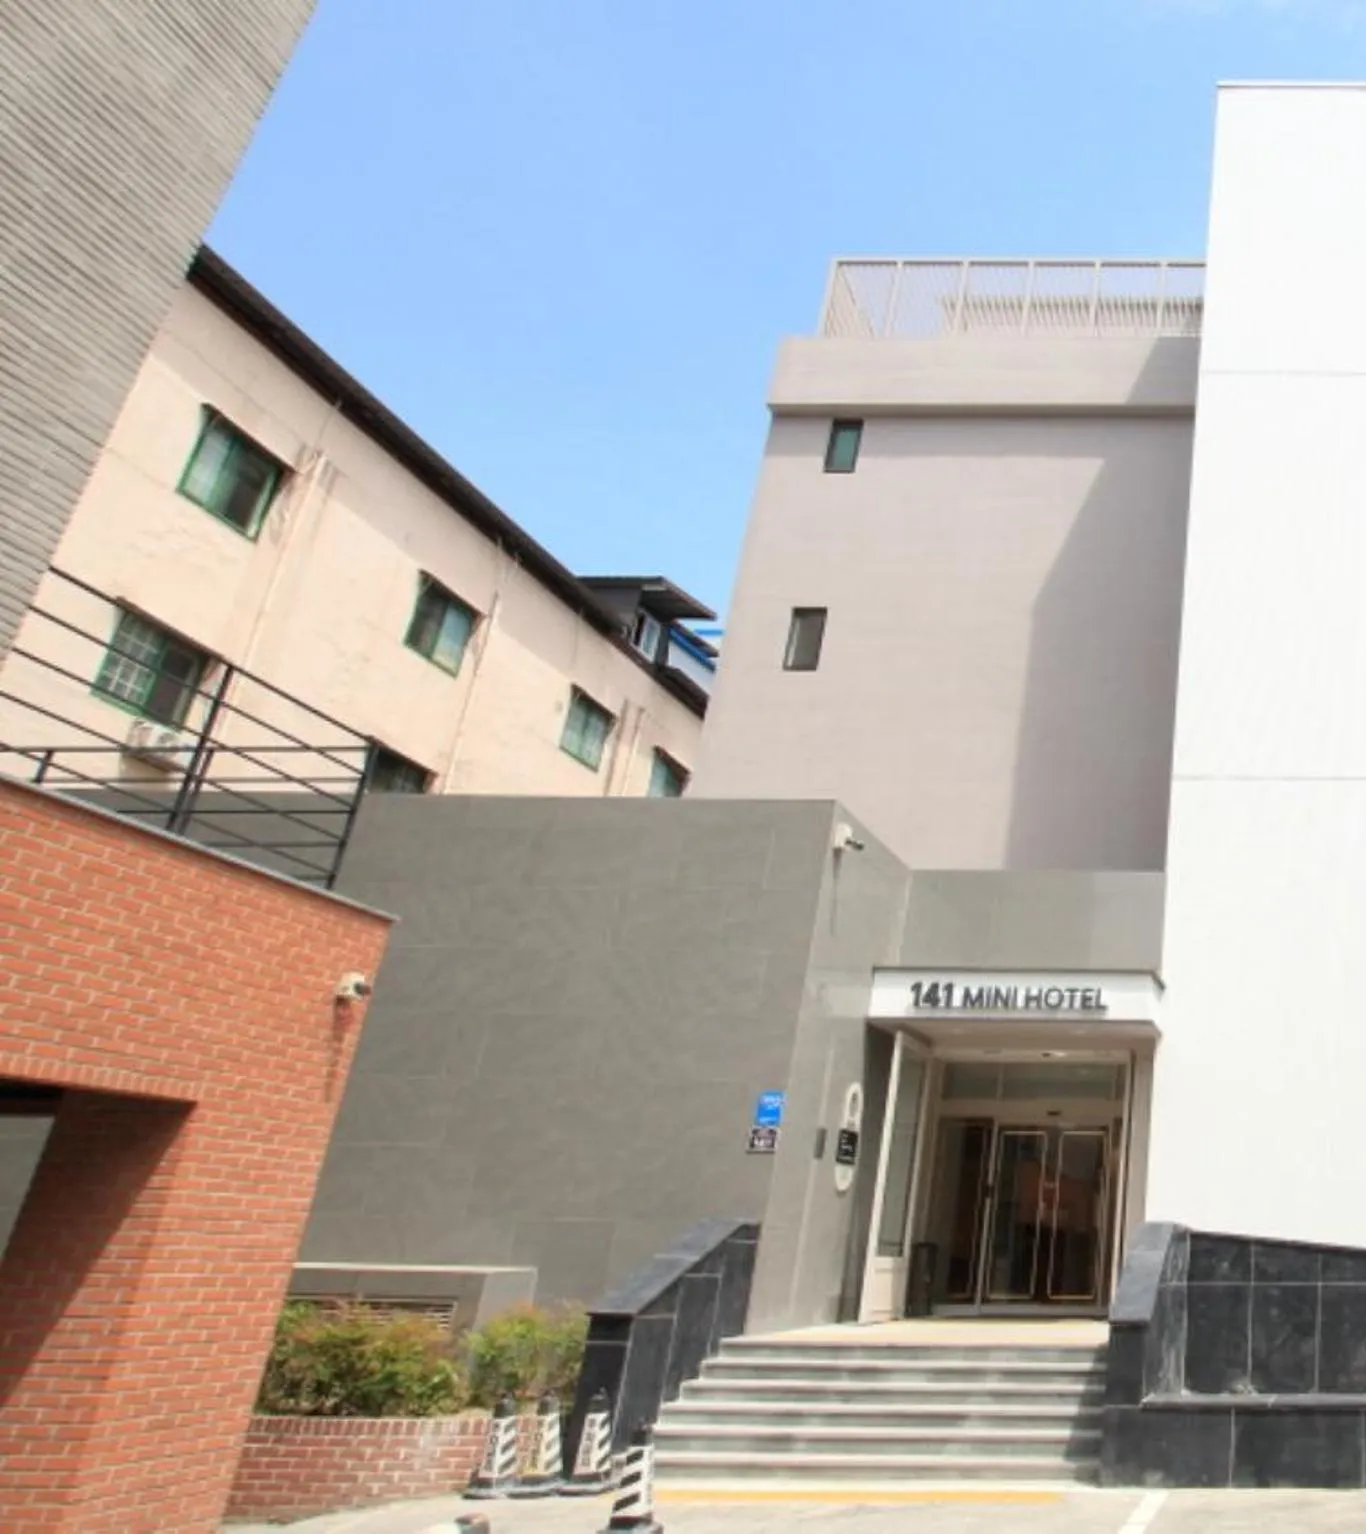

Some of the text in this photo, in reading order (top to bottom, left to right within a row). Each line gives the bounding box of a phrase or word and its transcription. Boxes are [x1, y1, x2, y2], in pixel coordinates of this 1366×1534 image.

[910, 981, 1108, 1012] 141 MINI HOTEL
